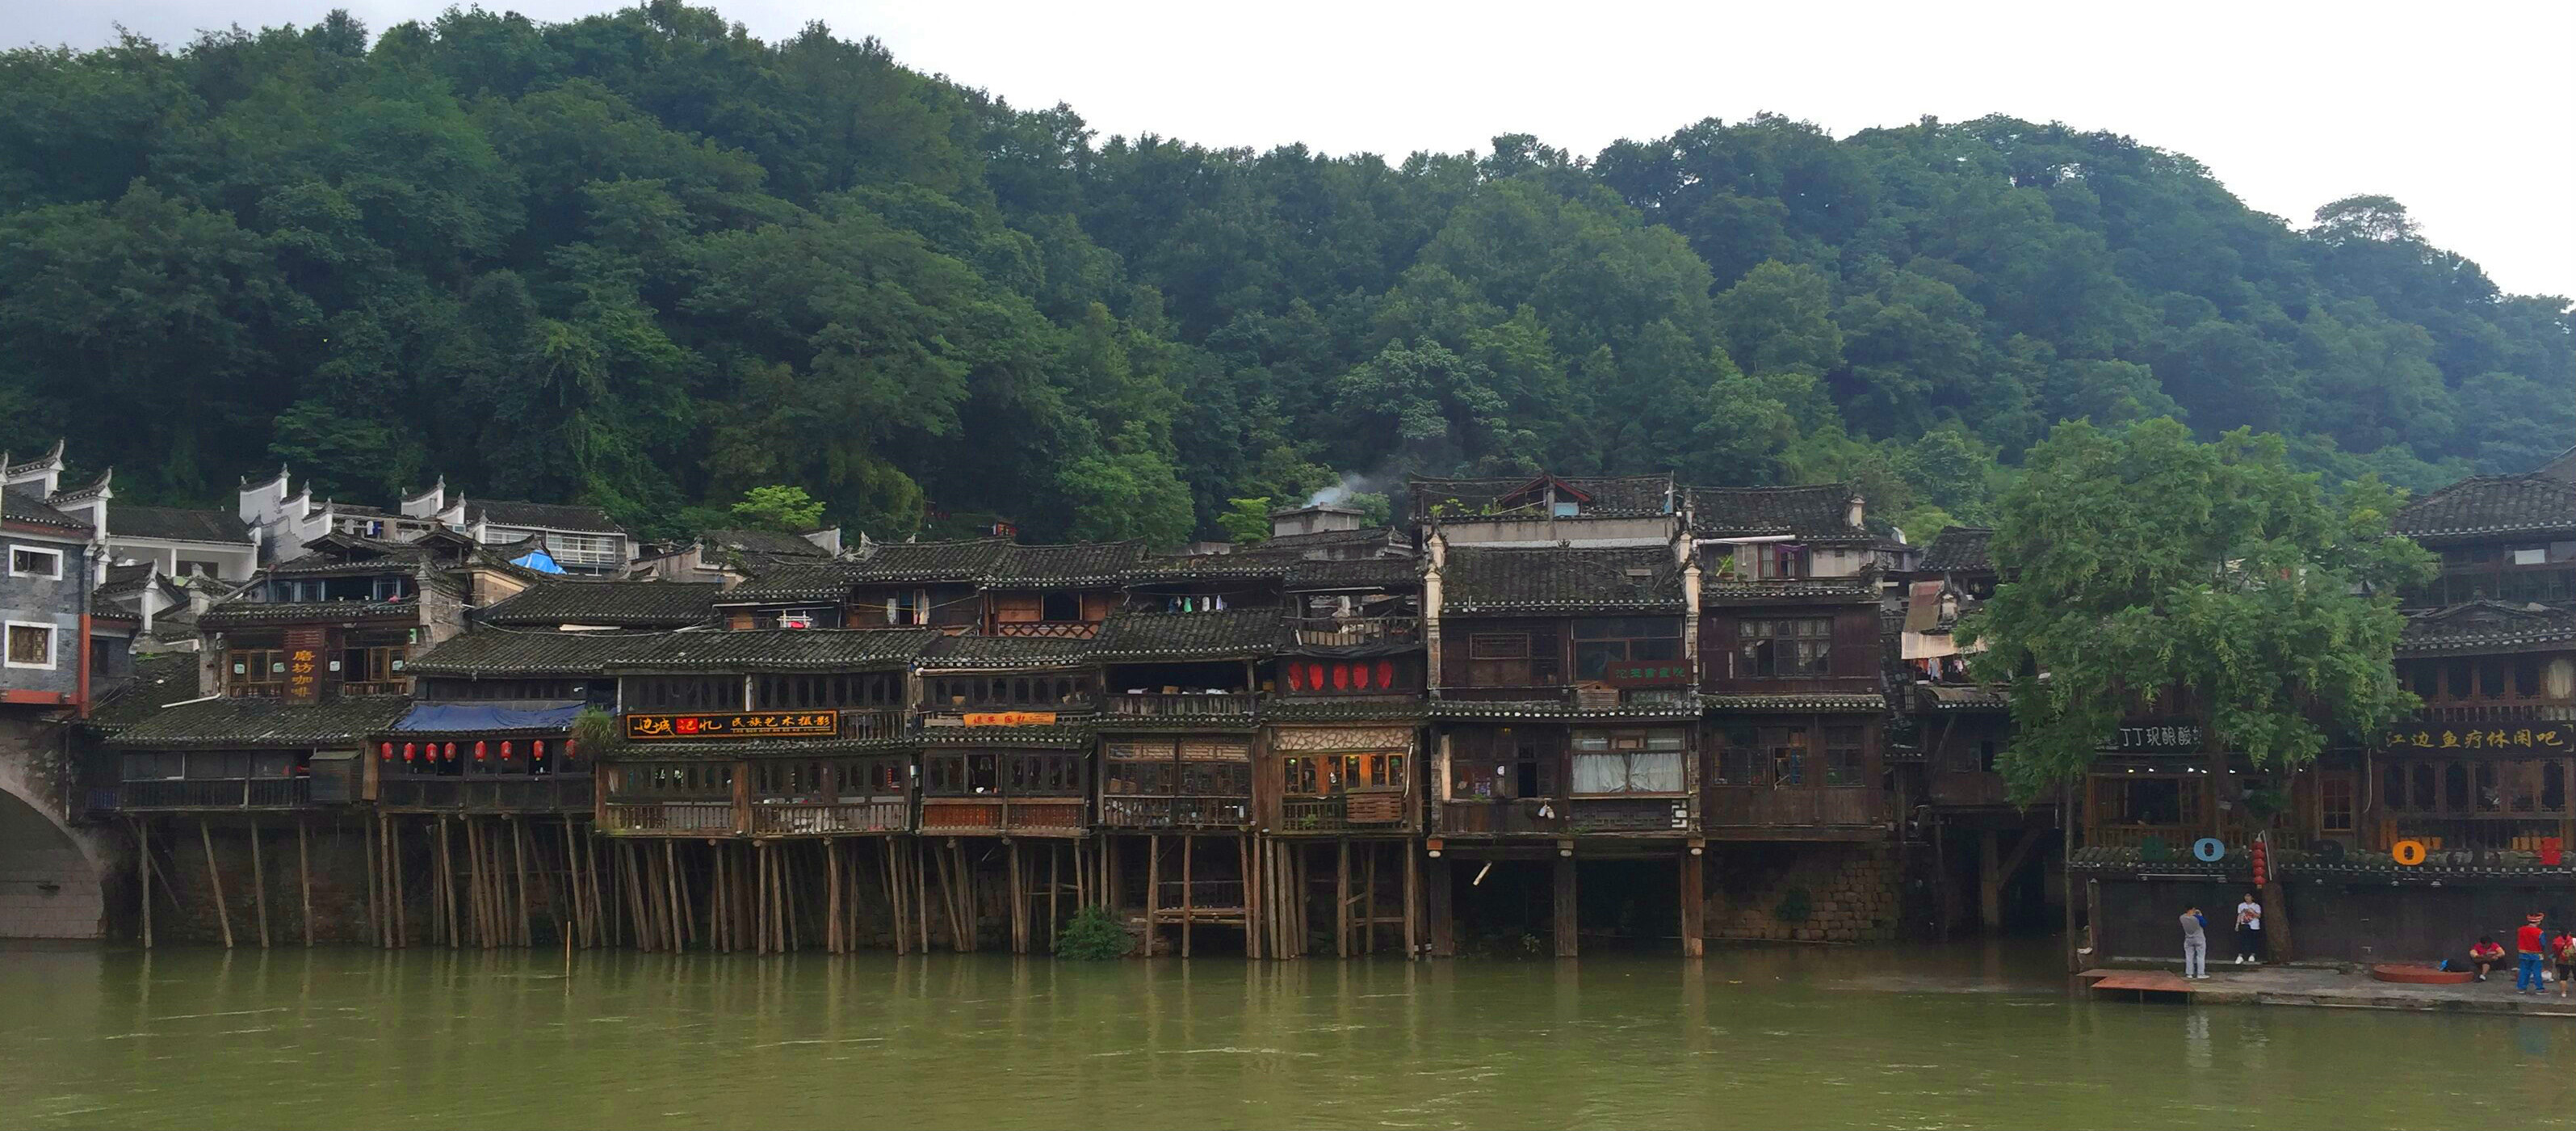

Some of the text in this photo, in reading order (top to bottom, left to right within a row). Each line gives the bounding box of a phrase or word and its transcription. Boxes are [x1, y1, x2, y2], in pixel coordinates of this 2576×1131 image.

[292, 650, 316, 697] 磨坊咖啡
[732, 716, 831, 727] 民族艺术摄影
[2386, 729, 2564, 749] 江边鱼疗休闲吧
